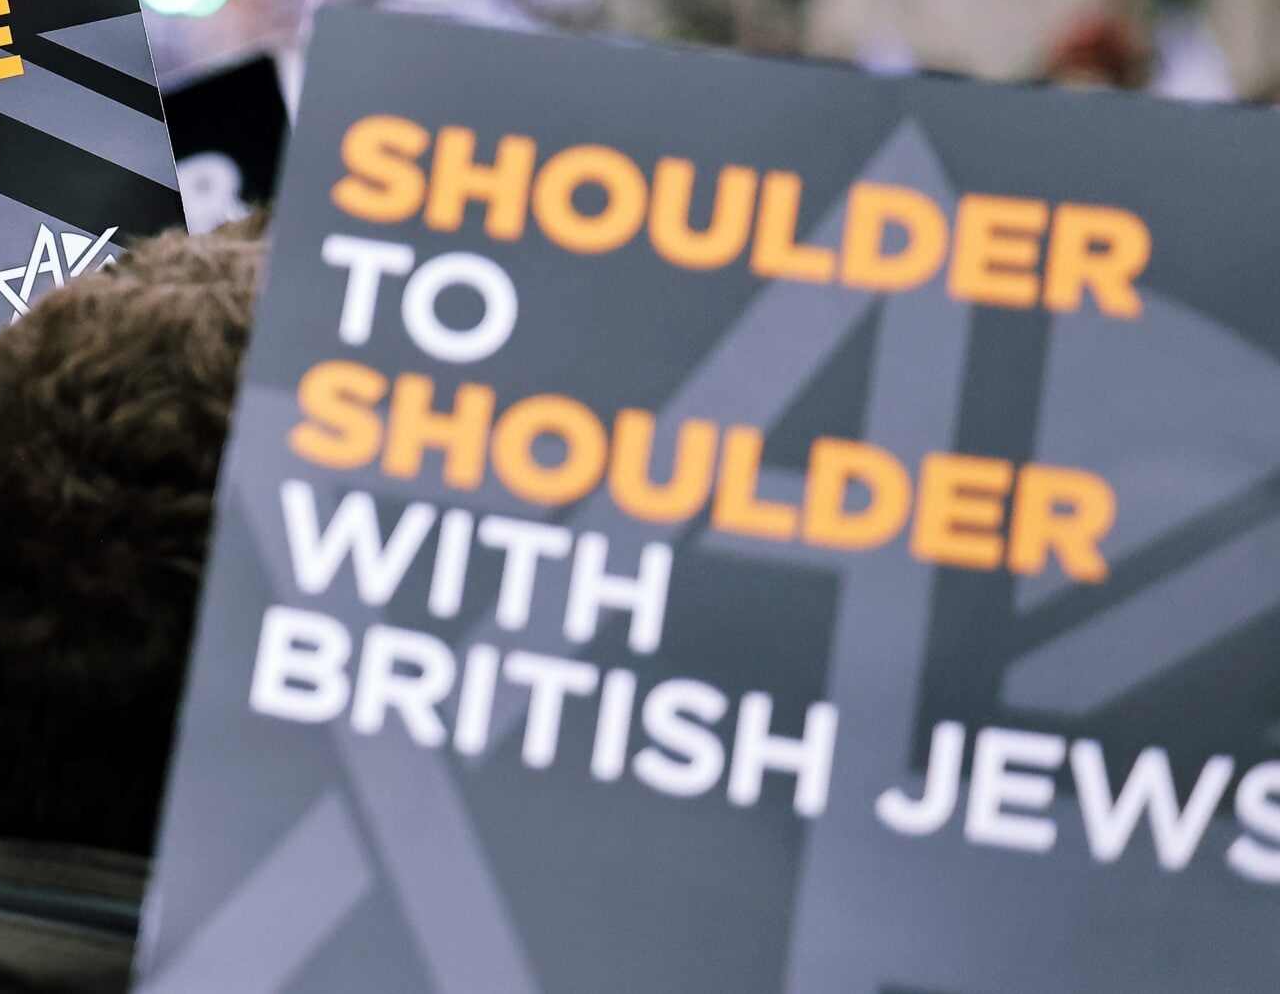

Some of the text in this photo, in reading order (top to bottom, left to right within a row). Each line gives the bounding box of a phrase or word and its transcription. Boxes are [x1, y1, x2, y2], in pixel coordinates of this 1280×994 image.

[322, 235, 519, 364] TO
[331, 116, 1152, 318] SHOULDER
[280, 481, 673, 654] WITH
[289, 363, 1117, 582] SHOULDER
[249, 606, 839, 818] BRITISH
